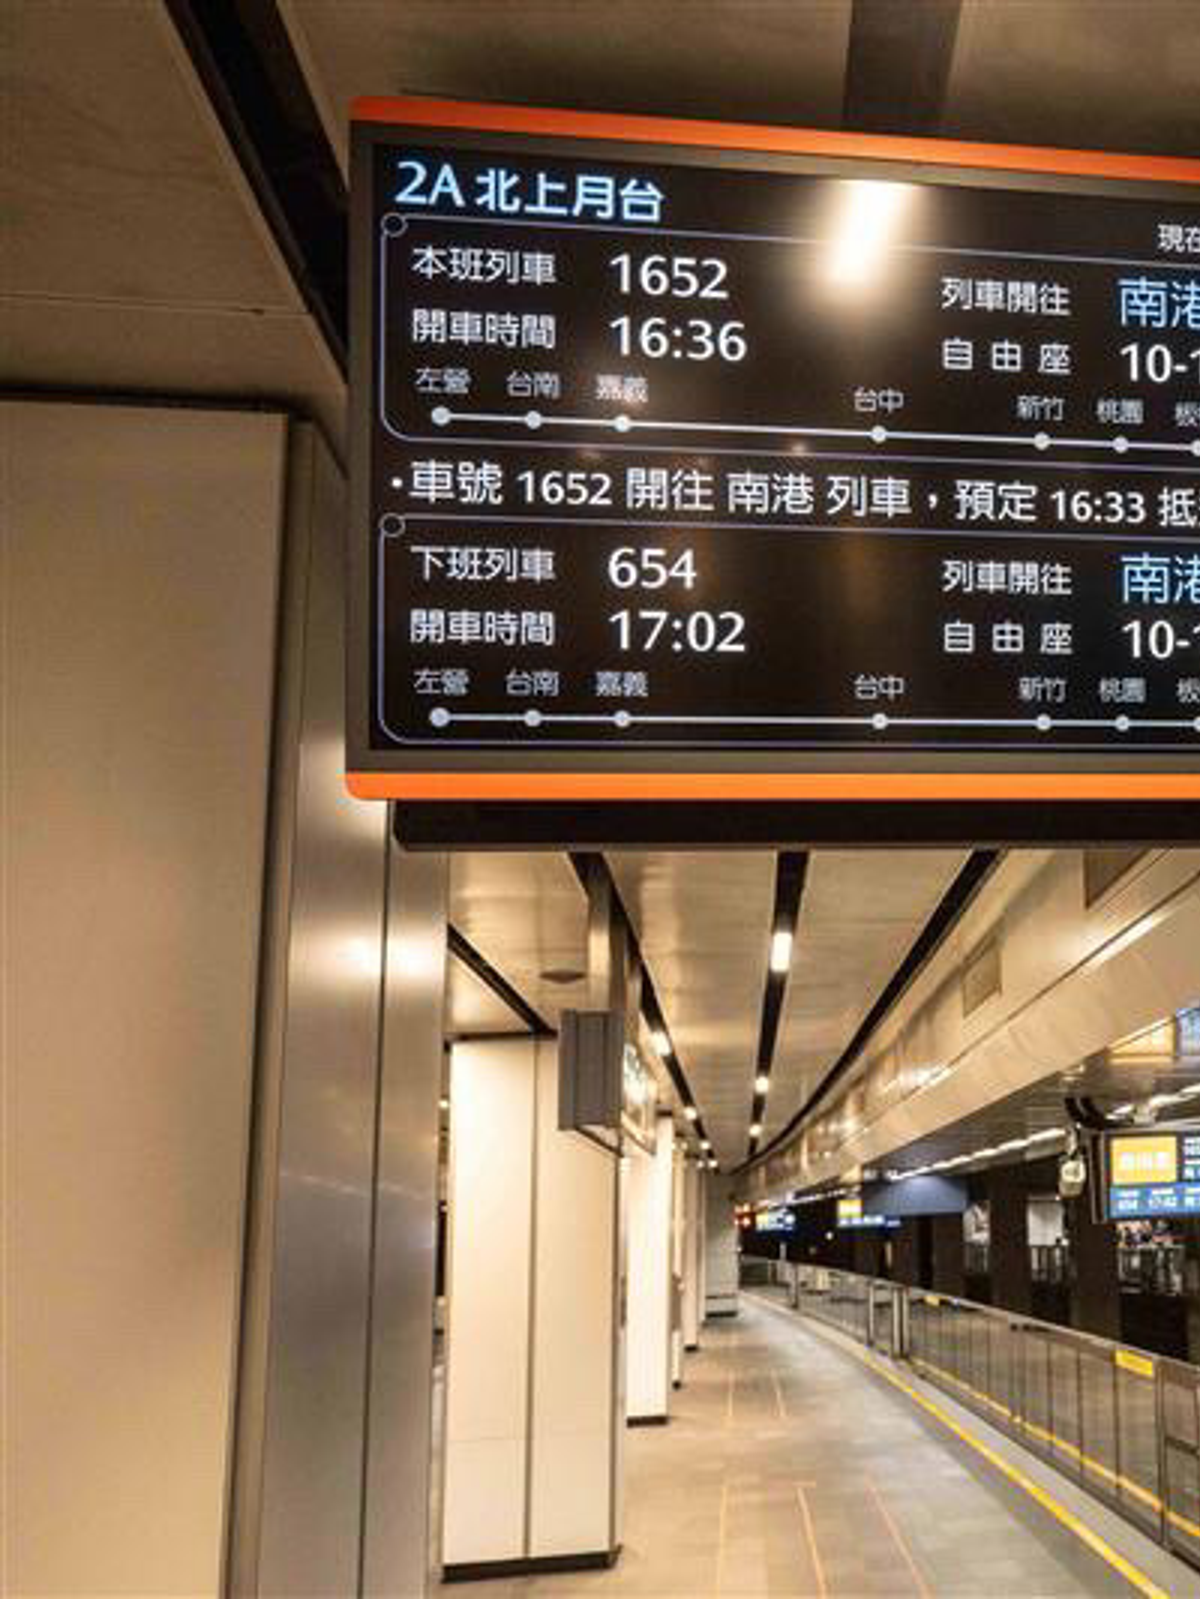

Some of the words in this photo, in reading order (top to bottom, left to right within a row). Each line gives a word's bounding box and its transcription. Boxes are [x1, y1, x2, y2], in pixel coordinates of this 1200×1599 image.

[413, 246, 555, 285] 本班列車
[611, 254, 728, 299] 1652
[941, 277, 1069, 315] 列車開往
[413, 309, 555, 348] 開車時間
[611, 316, 746, 361] 16:36
[507, 371, 560, 399] 台南
[854, 387, 903, 412] 台中
[1017, 395, 1064, 420] 新竹
[518, 471, 612, 505] 1652
[627, 468, 714, 510] 開往
[727, 472, 814, 513] 南港
[1051, 490, 1146, 523] 16:33
[411, 546, 554, 582] 下班列車
[609, 548, 697, 589] 654
[943, 561, 1071, 594] 列車開往
[411, 609, 554, 645] 開車時間
[610, 610, 745, 651] 17:02
[507, 669, 559, 696] 台南
[854, 675, 904, 699] 台中
[1020, 677, 1066, 702] 新竹
